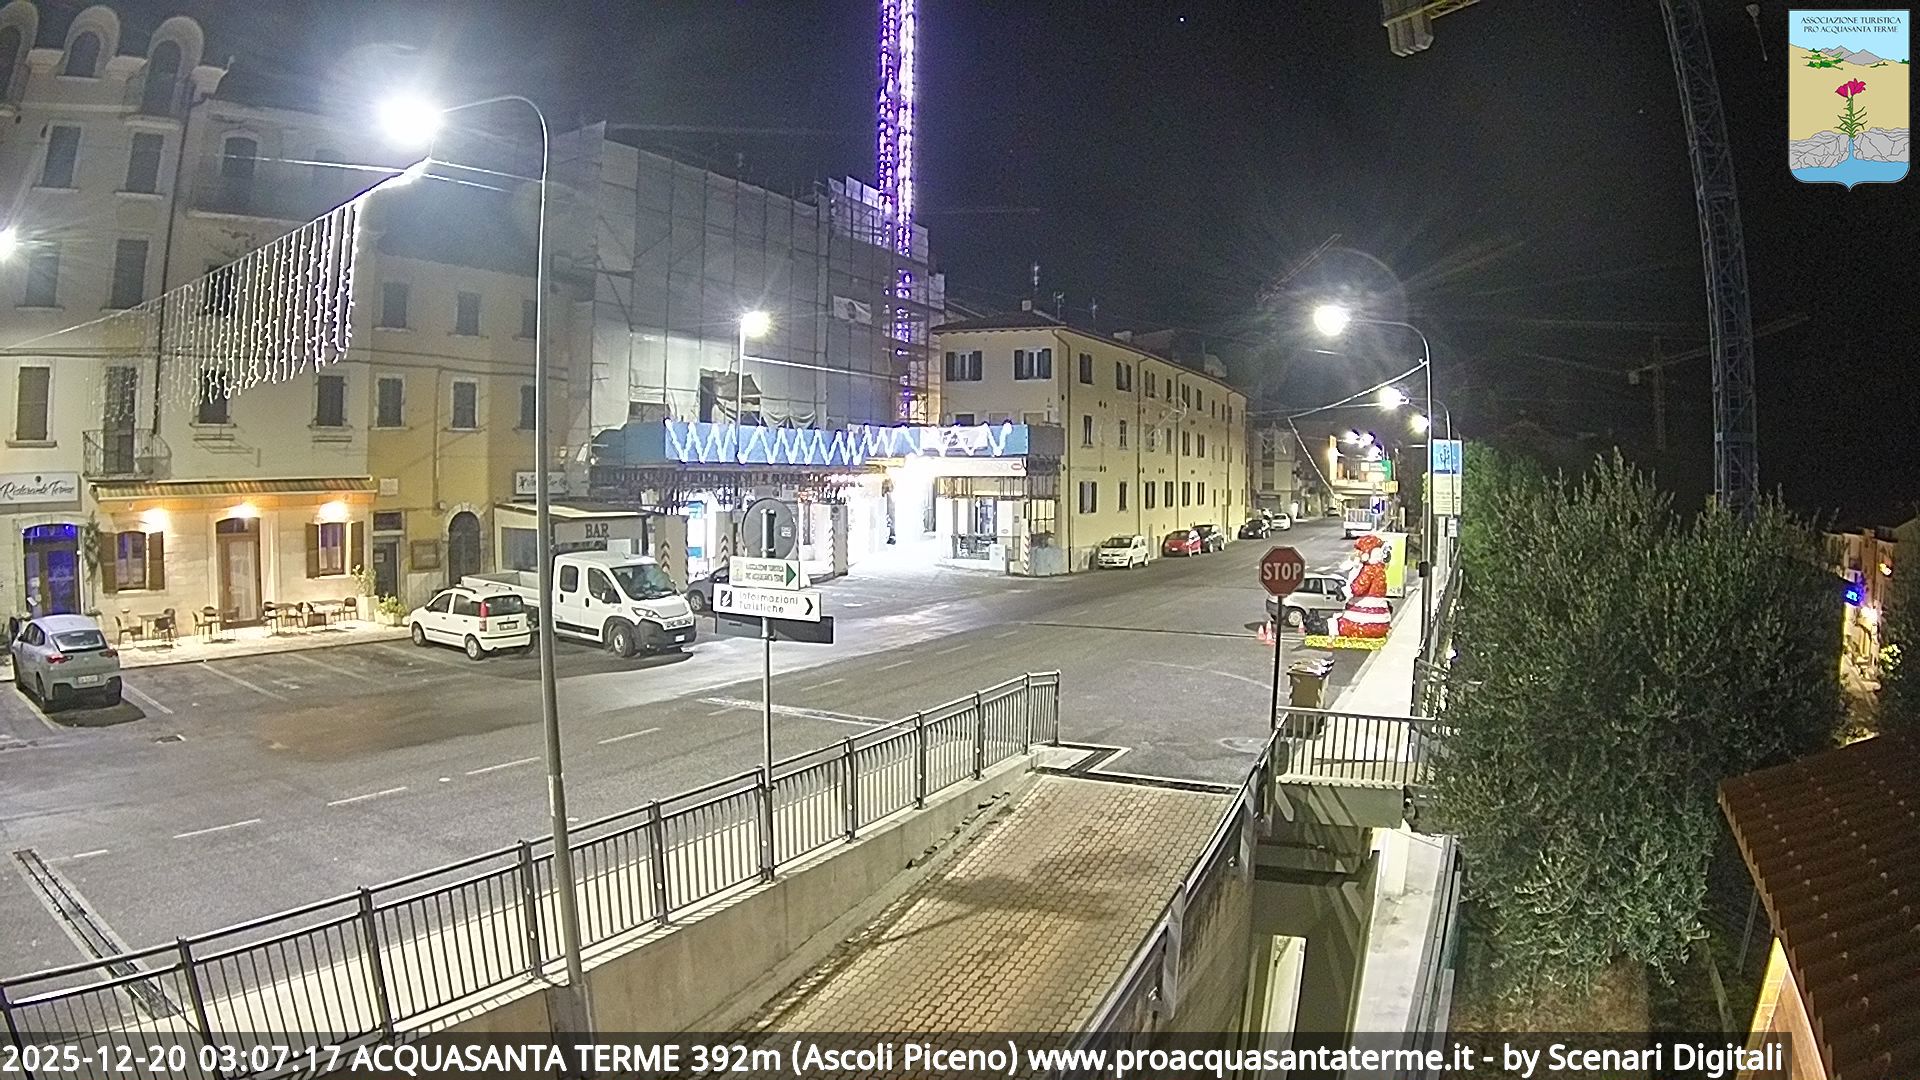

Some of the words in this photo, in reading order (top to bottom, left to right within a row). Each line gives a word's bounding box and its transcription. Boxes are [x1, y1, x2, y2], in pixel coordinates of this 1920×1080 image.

[585, 523, 610, 539] BAR
[1263, 562, 1302, 580] STOP
[739, 591, 799, 605] Informazioni
[739, 600, 784, 614] Turistiche
